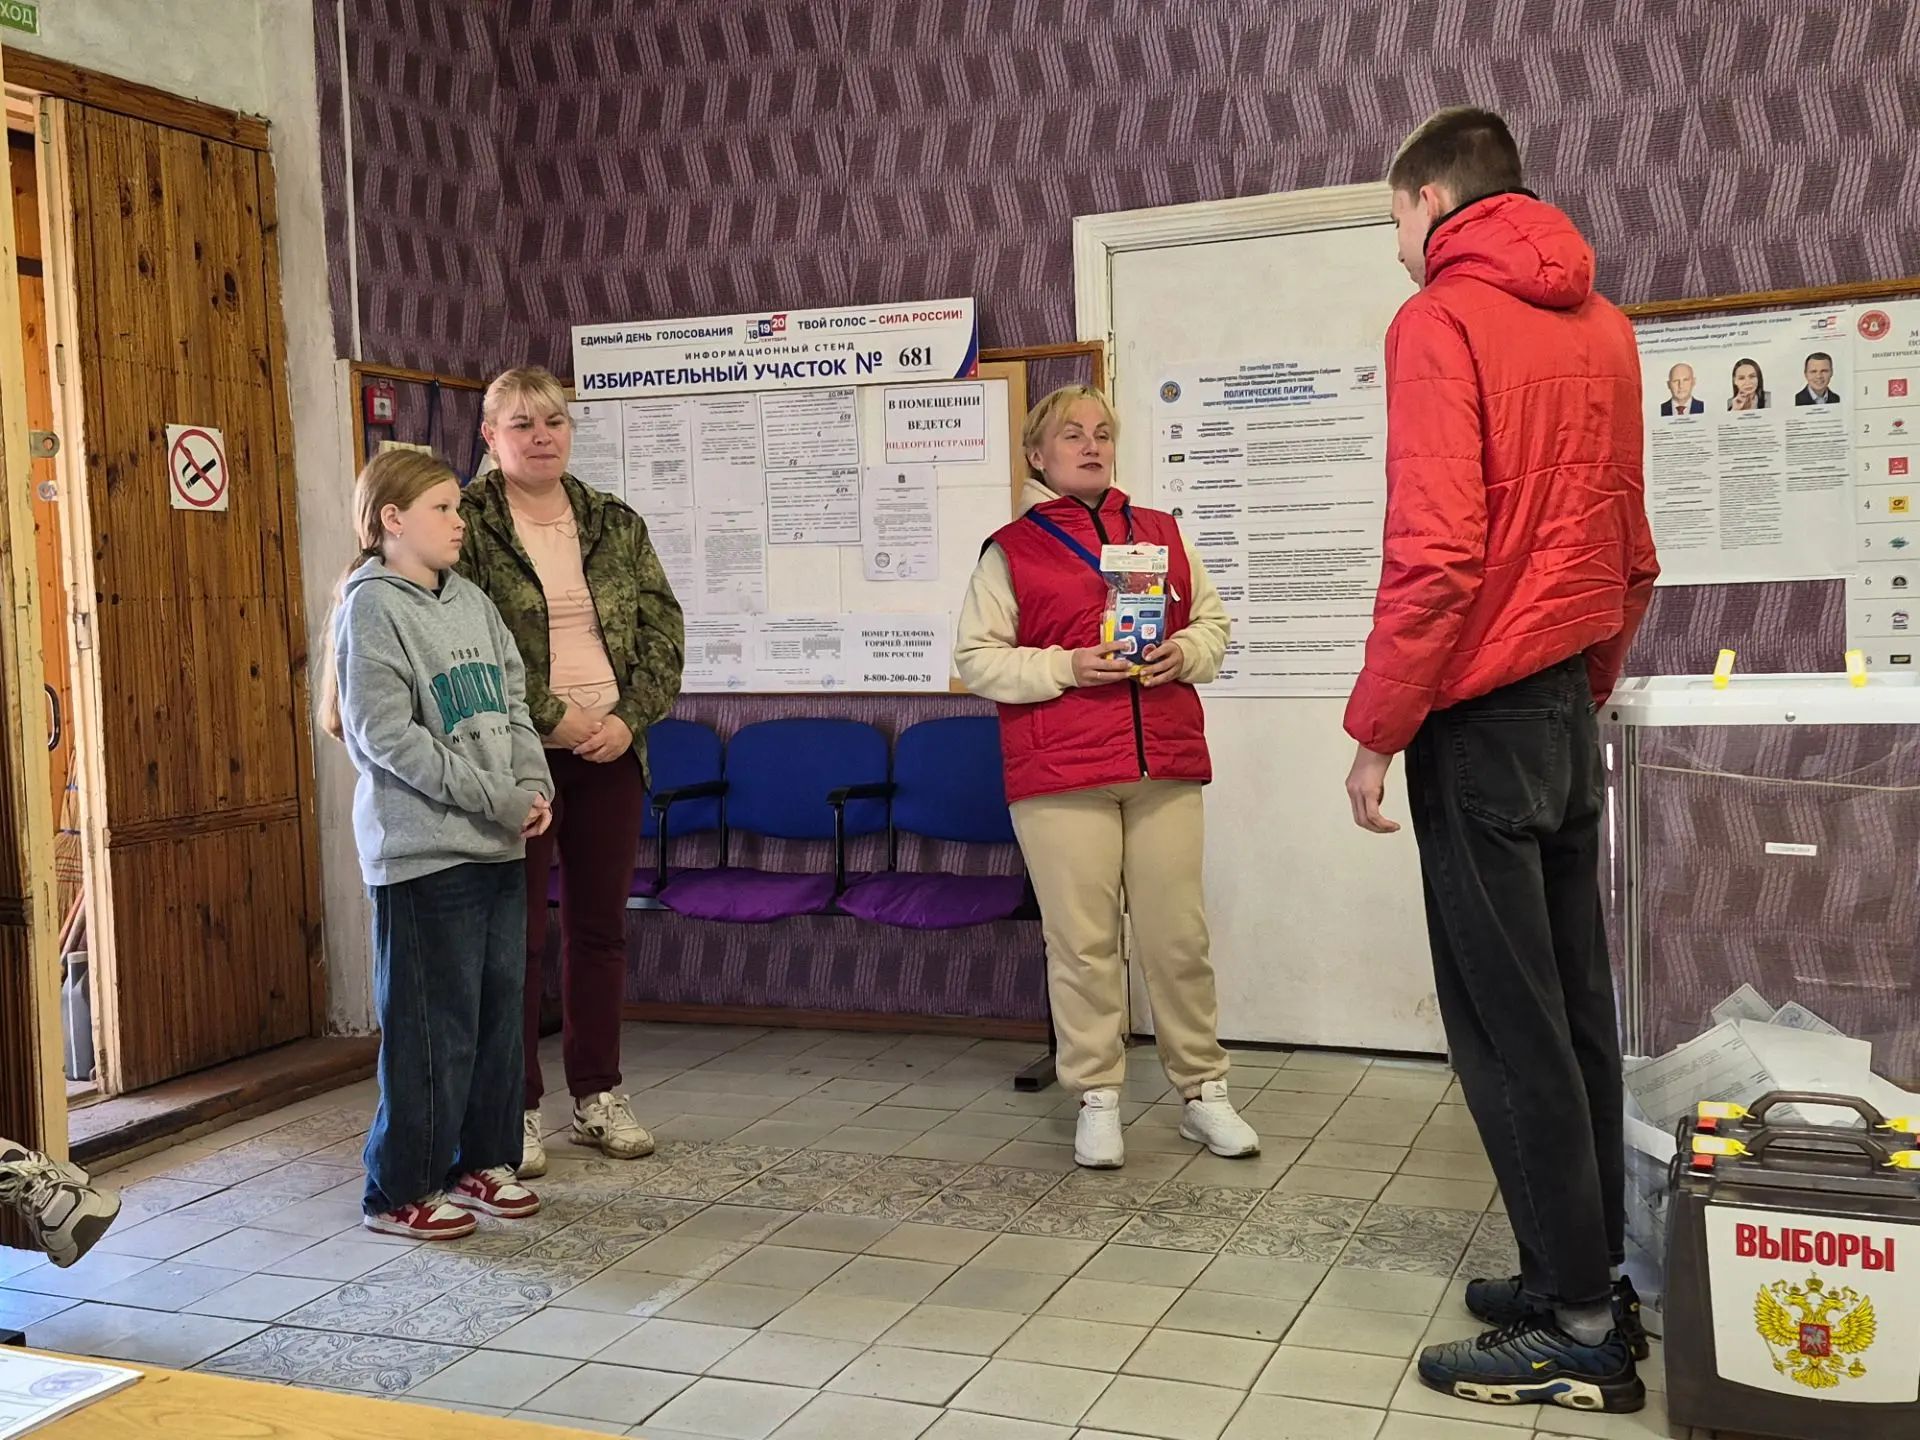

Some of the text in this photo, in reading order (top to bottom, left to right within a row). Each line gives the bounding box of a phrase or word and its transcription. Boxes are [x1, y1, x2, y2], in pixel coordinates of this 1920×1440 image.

[798, 317, 827, 330] ТВОЙ
[830, 316, 866, 328] ГОЛОС
[879, 314, 909, 326] СИЛА
[913, 310, 963, 323] РОССИИ!
[748, 318, 784, 340] 18 19 20
[581, 327, 733, 346] ЕДИНЫЙ ДЕНЬ ГОЛОСОВАНИЯ
[685, 342, 854, 360] ИНФОРМАЦИОННЫЙ СТЕНД
[583, 346, 932, 390] ИЗБИРАТЕЛЬНЫЙ УЧАСТОК № 681
[1224, 387, 1280, 398] ПОЛИТИЧЕСКИЕ
[1864, 386, 1868, 395] 1
[889, 396, 980, 410] В ПОМЕЩЕНИИ
[908, 418, 961, 430] ВЕДЕТСЯ
[1864, 424, 1870, 434] 2
[1864, 462, 1870, 472] 3
[1864, 500, 1870, 509] 4
[1864, 538, 1871, 548] 5
[1865, 576, 1872, 585] 6
[1865, 614, 1872, 623] 7
[862, 630, 934, 638] НОМЕР ТЕЛЕФОНА
[1866, 656, 1872, 665] 8
[864, 674, 931, 682] 8-800-200-00-20
[1736, 1222, 1895, 1272] ВЫБОРЫ
